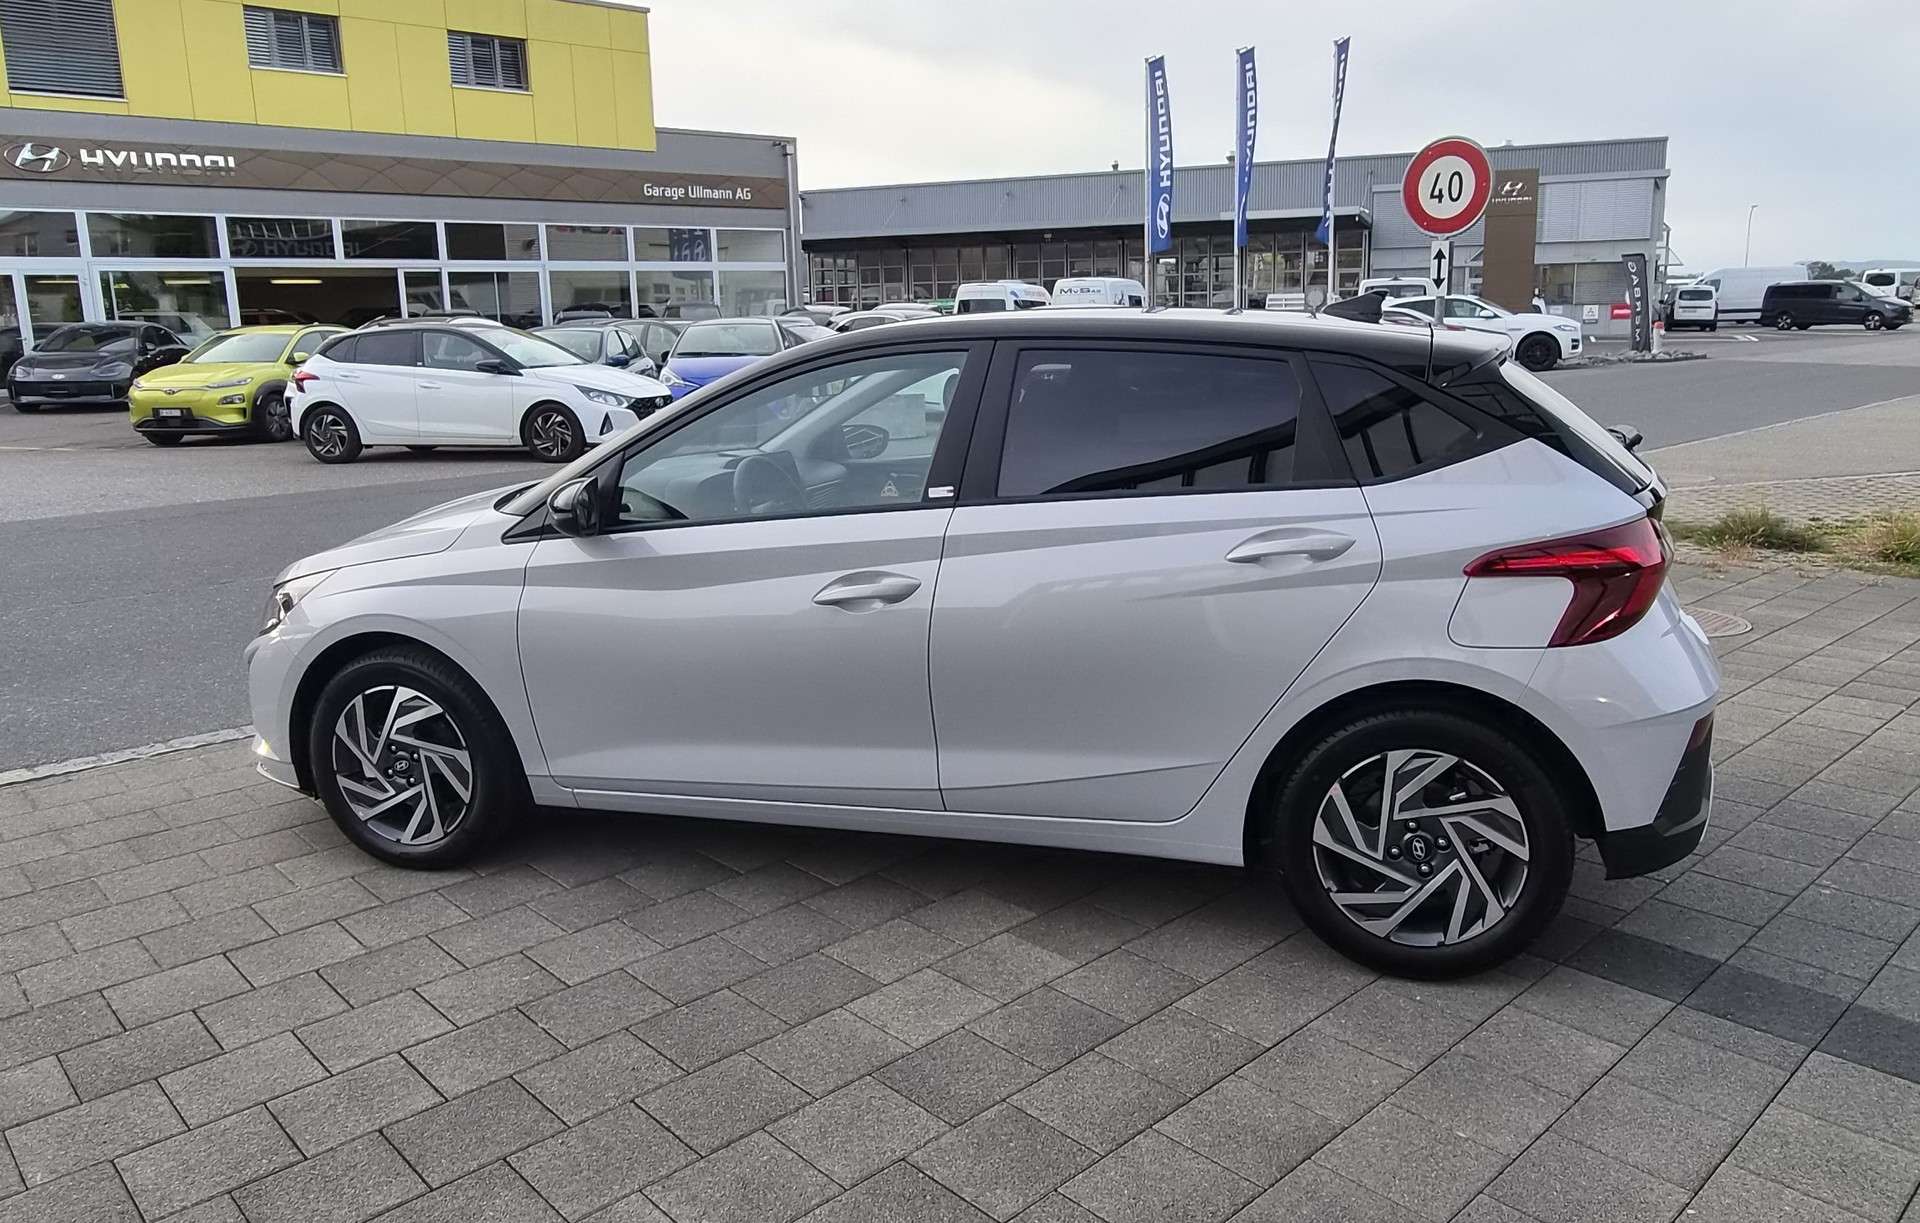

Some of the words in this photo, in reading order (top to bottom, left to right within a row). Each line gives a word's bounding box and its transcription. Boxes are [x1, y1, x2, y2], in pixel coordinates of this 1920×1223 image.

[1154, 70, 1171, 187] HYUNDAI
[79, 148, 236, 176] HYUNDAI
[643, 183, 685, 200] Garage
[688, 185, 733, 200] Ullmann
[735, 187, 752, 200] AG
[1429, 170, 1464, 204] 40
